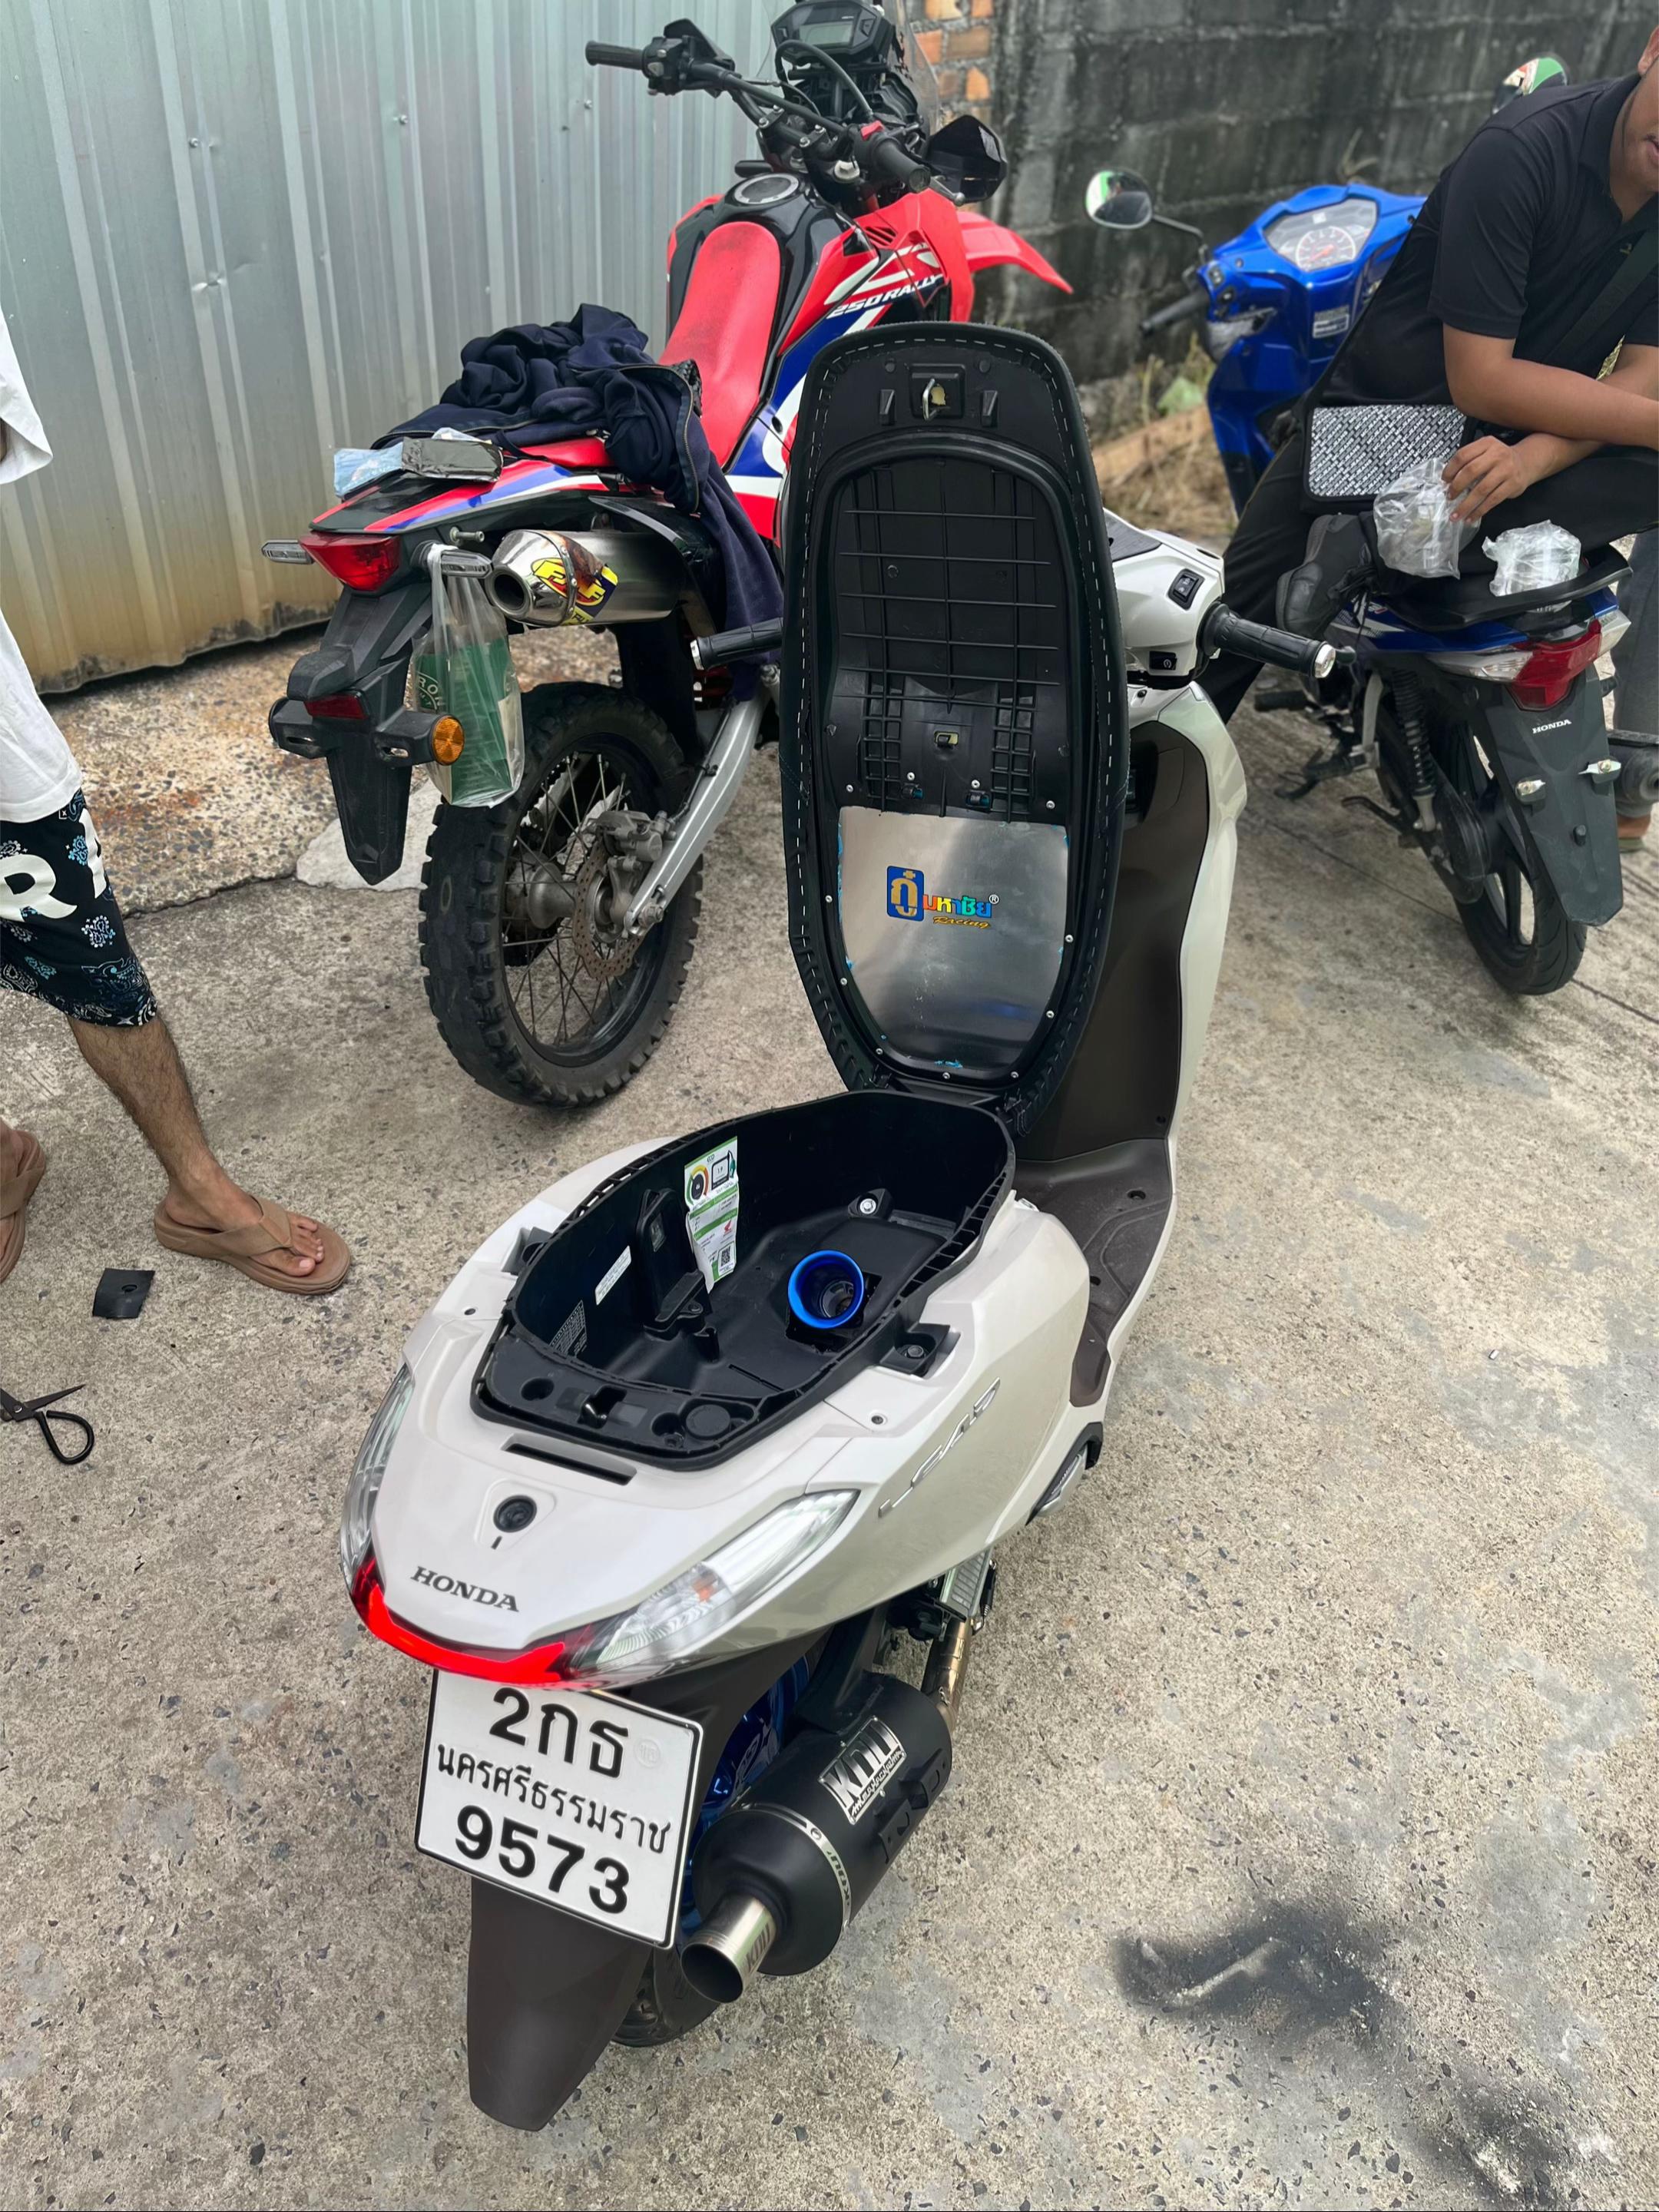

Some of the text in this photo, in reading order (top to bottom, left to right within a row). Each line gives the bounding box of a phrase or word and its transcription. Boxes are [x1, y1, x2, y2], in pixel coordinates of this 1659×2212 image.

[826, 273, 944, 320] 250 RALLY
[1532, 719, 1572, 734] HONDA
[932, 916, 991, 929] Racing
[410, 1565, 520, 1613] HONDA
[488, 1687, 629, 1779] 2กธ
[437, 1743, 671, 1854] นครศรีธรรมราช
[454, 1804, 631, 1915] 9573
